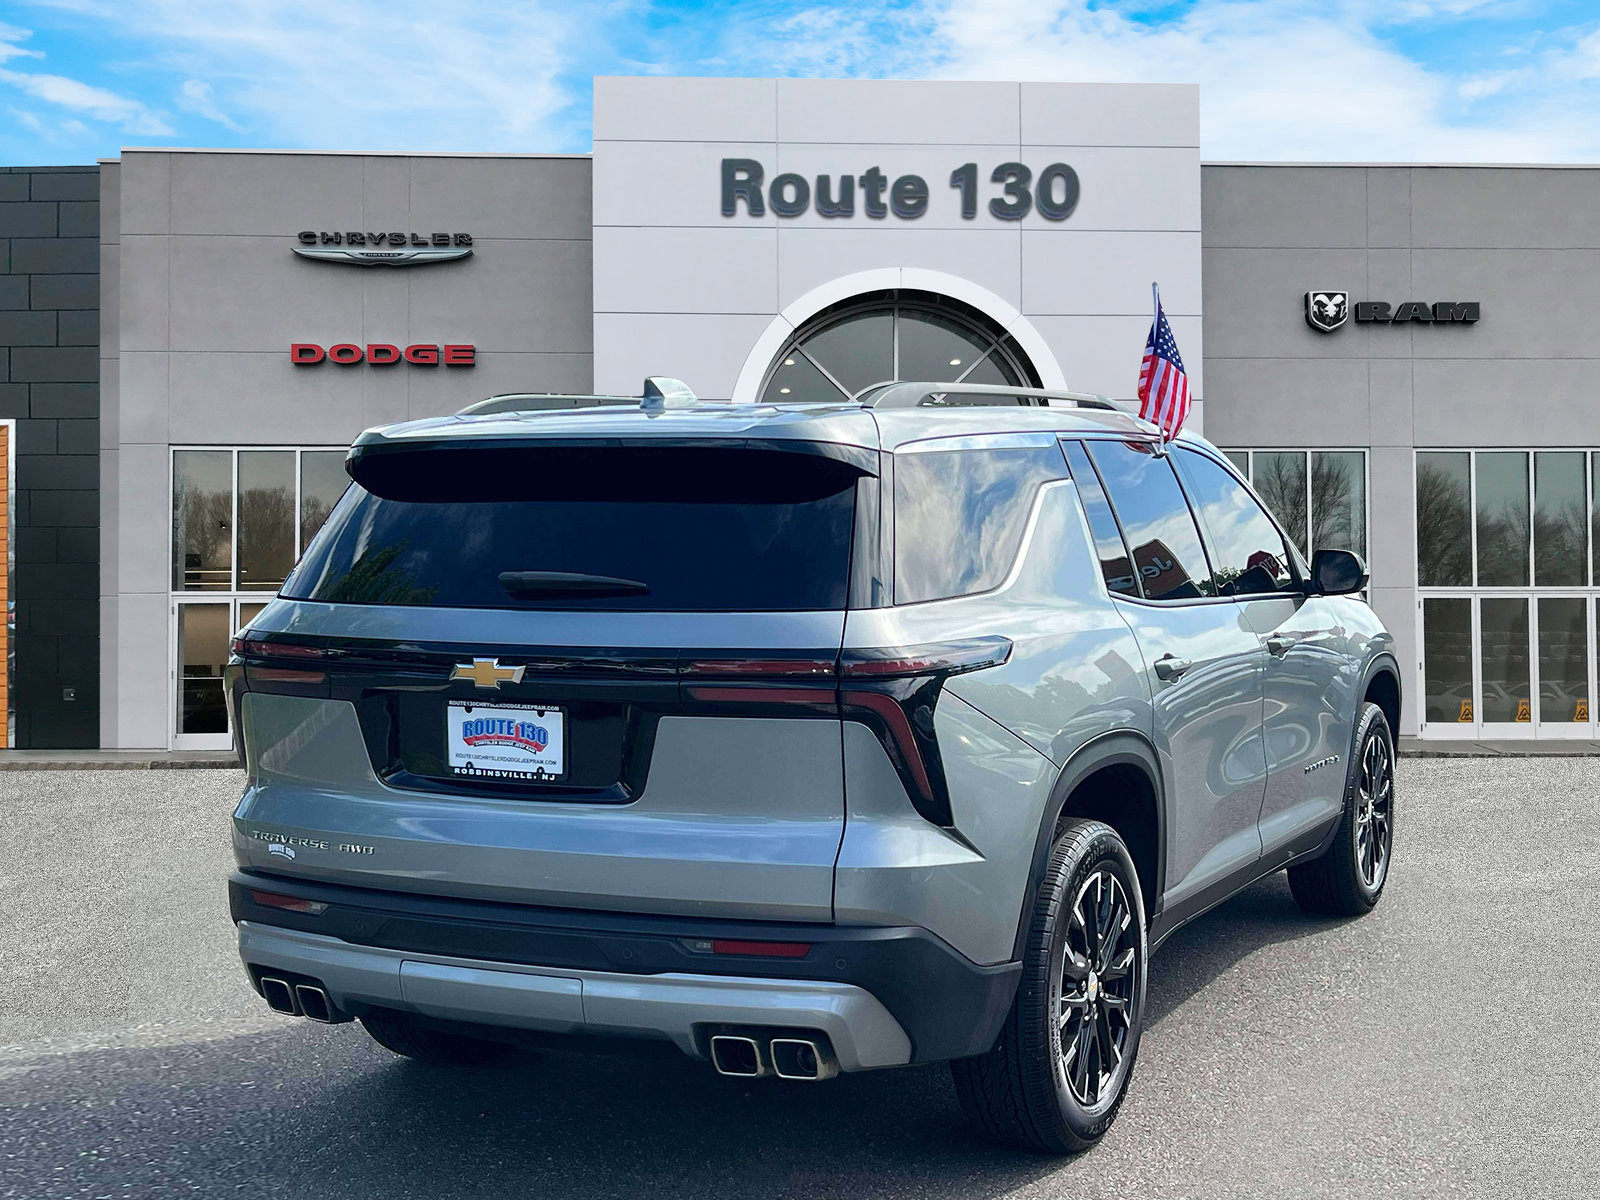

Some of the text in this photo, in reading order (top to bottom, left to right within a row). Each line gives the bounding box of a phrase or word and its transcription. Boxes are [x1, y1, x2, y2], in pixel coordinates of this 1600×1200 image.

[721, 158, 1081, 220] Route 130
[298, 231, 473, 246] CHRYSLER
[1355, 301, 1481, 324] RAM
[291, 343, 476, 365] DODGE
[462, 718, 549, 745] ROUTE 130
[454, 766, 556, 781] ROBBINSVILLE, NJ
[252, 830, 375, 856] TRAVERSE AWD
